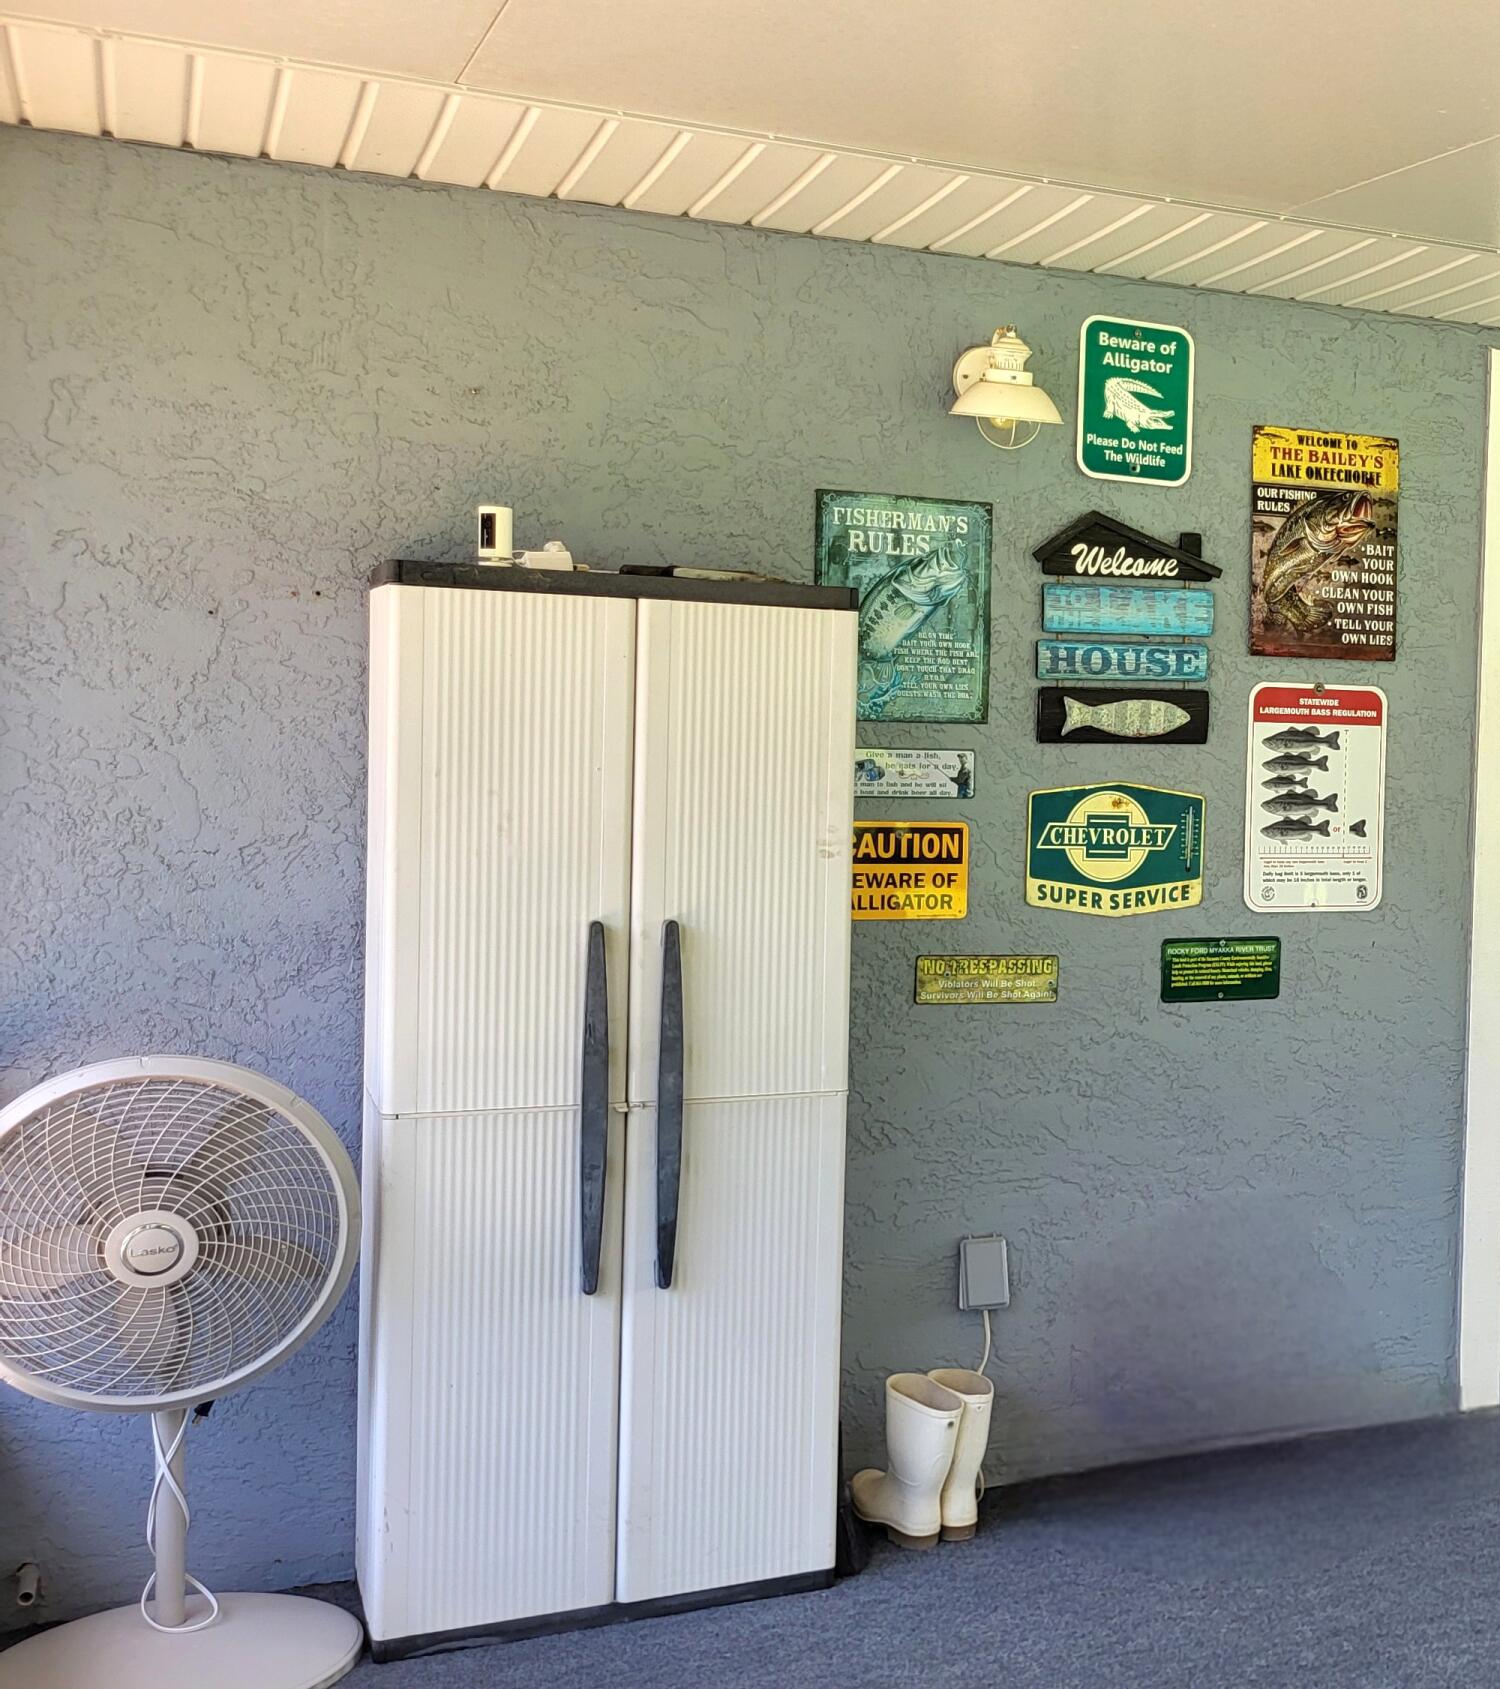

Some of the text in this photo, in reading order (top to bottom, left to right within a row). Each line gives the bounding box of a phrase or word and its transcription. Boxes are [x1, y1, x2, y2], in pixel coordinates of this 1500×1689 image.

[1099, 332, 1177, 356] Beware of
[1102, 352, 1173, 374] Alligator
[1086, 434, 1183, 455] Please Do Not Feed
[1297, 435, 1358, 450] WELCOME TO
[1104, 450, 1166, 467] The Wildlife
[1270, 447, 1384, 469] THE BAILEY'S
[1271, 463, 1382, 487] LAKE OKEECHOBEE
[1257, 487, 1317, 501] OUR FISHING
[1257, 501, 1290, 513] RULES
[832, 507, 969, 534] FISHERMAN'S
[848, 530, 930, 556] RULES
[1366, 544, 1395, 557] BAIT
[1071, 543, 1180, 577] Welcome
[1362, 558, 1394, 571] YOUR
[1331, 570, 1394, 585] OWN HOOK
[1321, 586, 1394, 602] CLEAN YOUR
[1099, 588, 1213, 633] LAKE
[1337, 602, 1393, 616] OWN FISH
[1334, 618, 1394, 632] TELL YOUR
[920, 640, 937, 648] YOUR
[1342, 633, 1393, 646] OWN LIES
[911, 648, 935, 656] WHERE
[1046, 646, 1201, 677] HOUSE
[917, 665, 937, 673] TOUCH
[939, 666, 956, 674] THAT
[1299, 698, 1340, 706] STATEWIDE
[1260, 707, 1377, 718] LARGEMOUTH BASS REGULATION
[866, 751, 884, 759] Give
[924, 752, 941, 760] fish,
[942, 762, 959, 771] day.
[1050, 827, 1166, 846] CHEVROLET
[852, 833, 960, 858] AUTION
[852, 872, 959, 889] EWARE OF
[1037, 884, 1190, 910] SUPER SERVICE
[1209, 946, 1234, 954] MYAKKA
[1235, 945, 1254, 953] RIVER
[923, 959, 1053, 975] NO TRESPASSING
[938, 980, 1036, 989] Violators Will Be Shot
[920, 989, 1053, 1000] Survivors Will Be Shot Again!
[130, 1244, 177, 1257] Lasko
